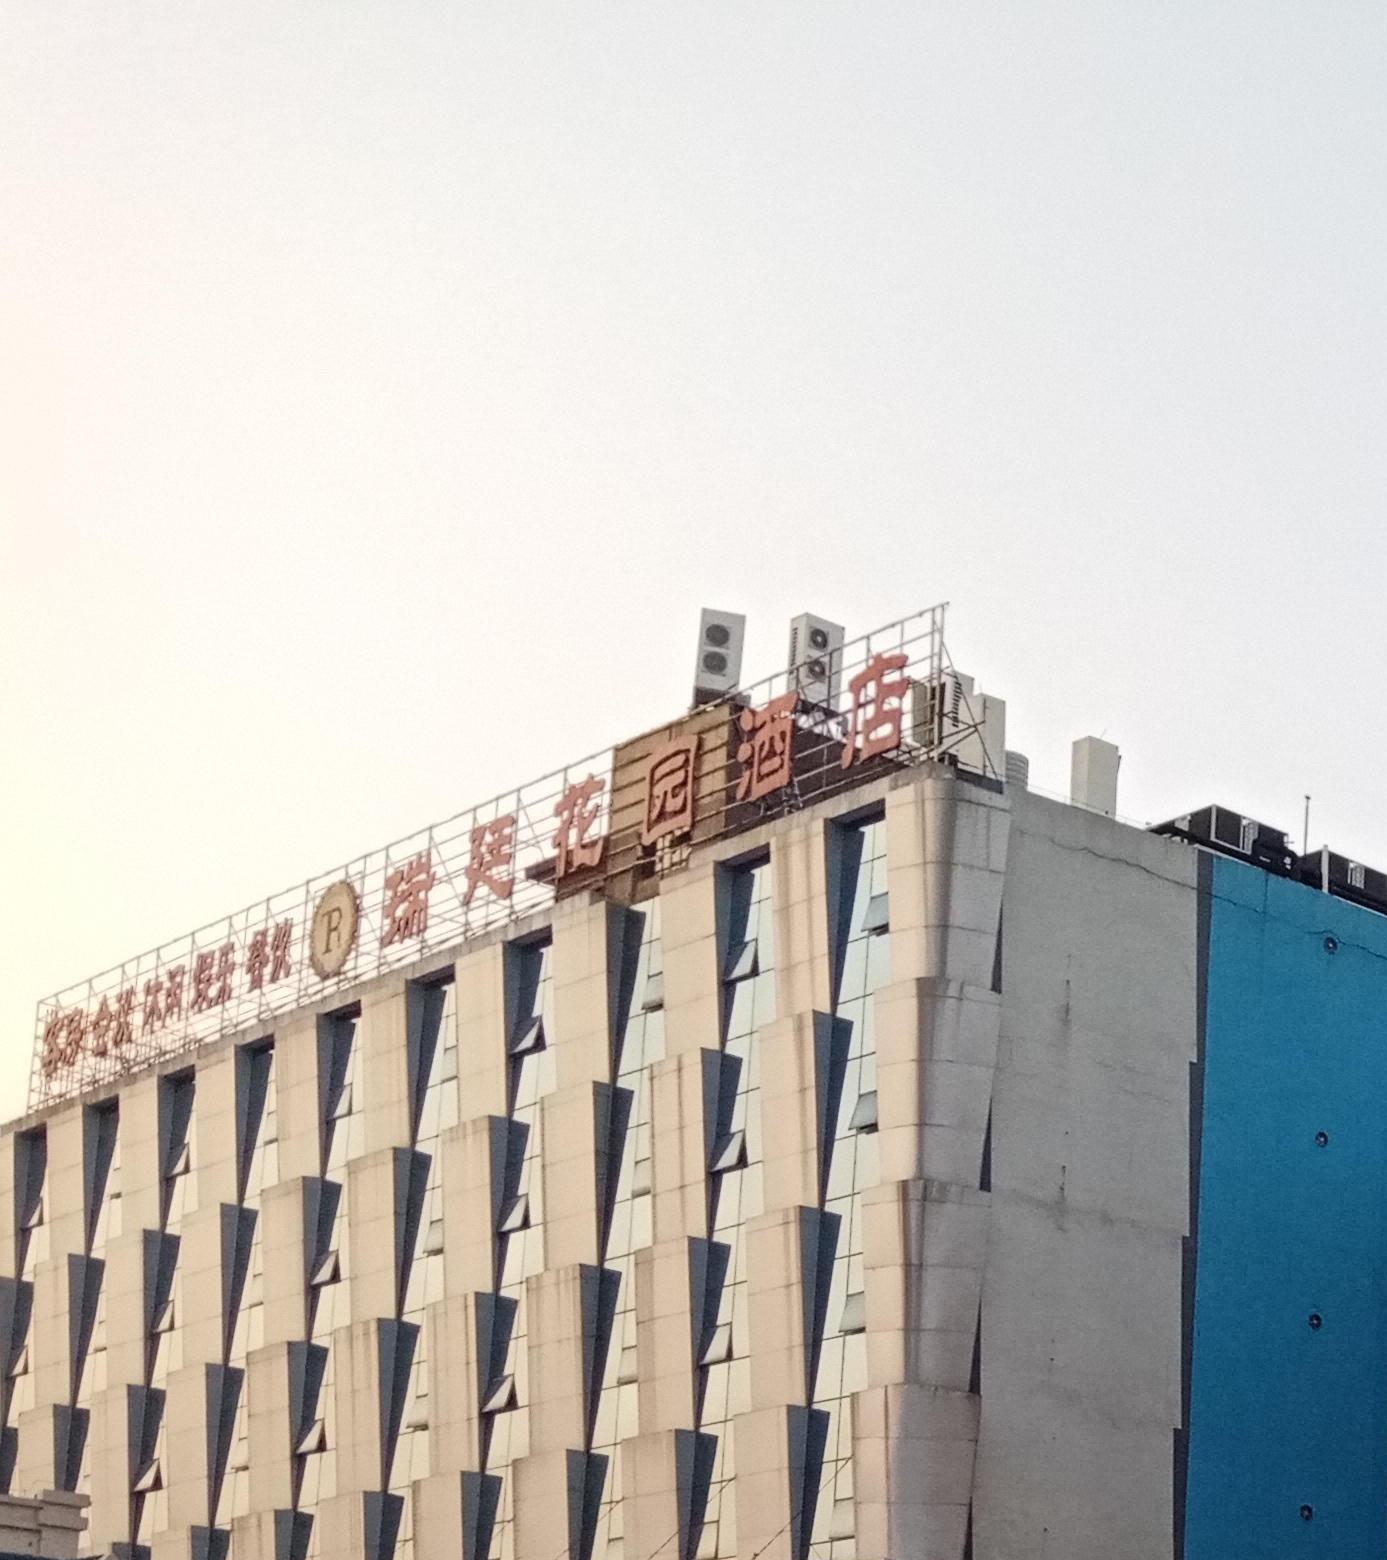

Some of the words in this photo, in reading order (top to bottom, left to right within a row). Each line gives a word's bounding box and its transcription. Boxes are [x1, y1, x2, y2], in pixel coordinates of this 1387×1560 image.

[381, 653, 909, 948] 瑞廷花园酒店
